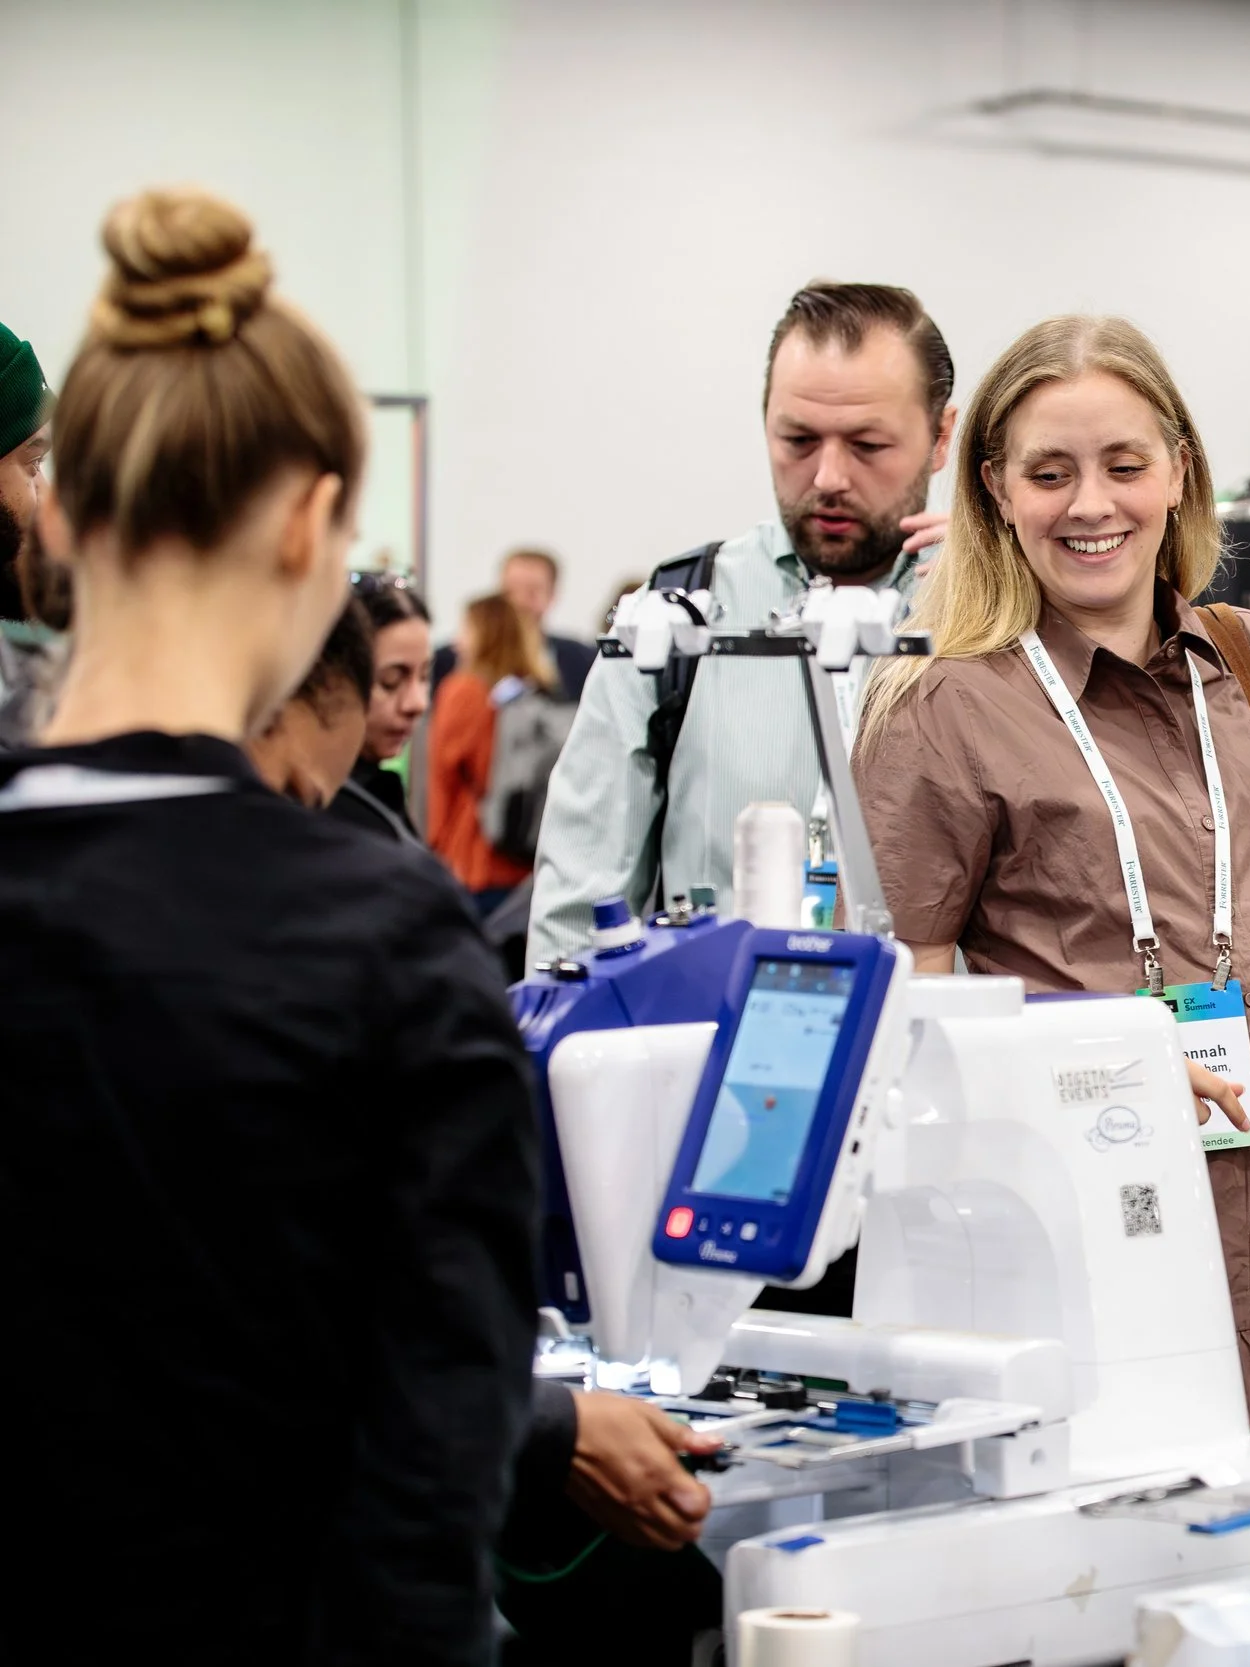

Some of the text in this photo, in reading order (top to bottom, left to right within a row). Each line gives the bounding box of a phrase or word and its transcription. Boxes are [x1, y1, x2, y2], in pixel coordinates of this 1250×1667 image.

[1029, 645, 1057, 687] FORRESTER
[1065, 709, 1093, 753] FORRESTER
[1102, 780, 1126, 827] FORRESTER
[1212, 784, 1227, 830] FORRESTER
[1126, 860, 1143, 914] FORRESTER
[1219, 860, 1228, 910] FORRESTER
[1184, 997, 1195, 1005] CX
[1185, 1002, 1217, 1012] Summit
[1183, 1045, 1227, 1060] annah
[1204, 1063, 1232, 1073] ham,
[1059, 1085, 1109, 1104] EVENTS
[1202, 1137, 1234, 1148] tendee
